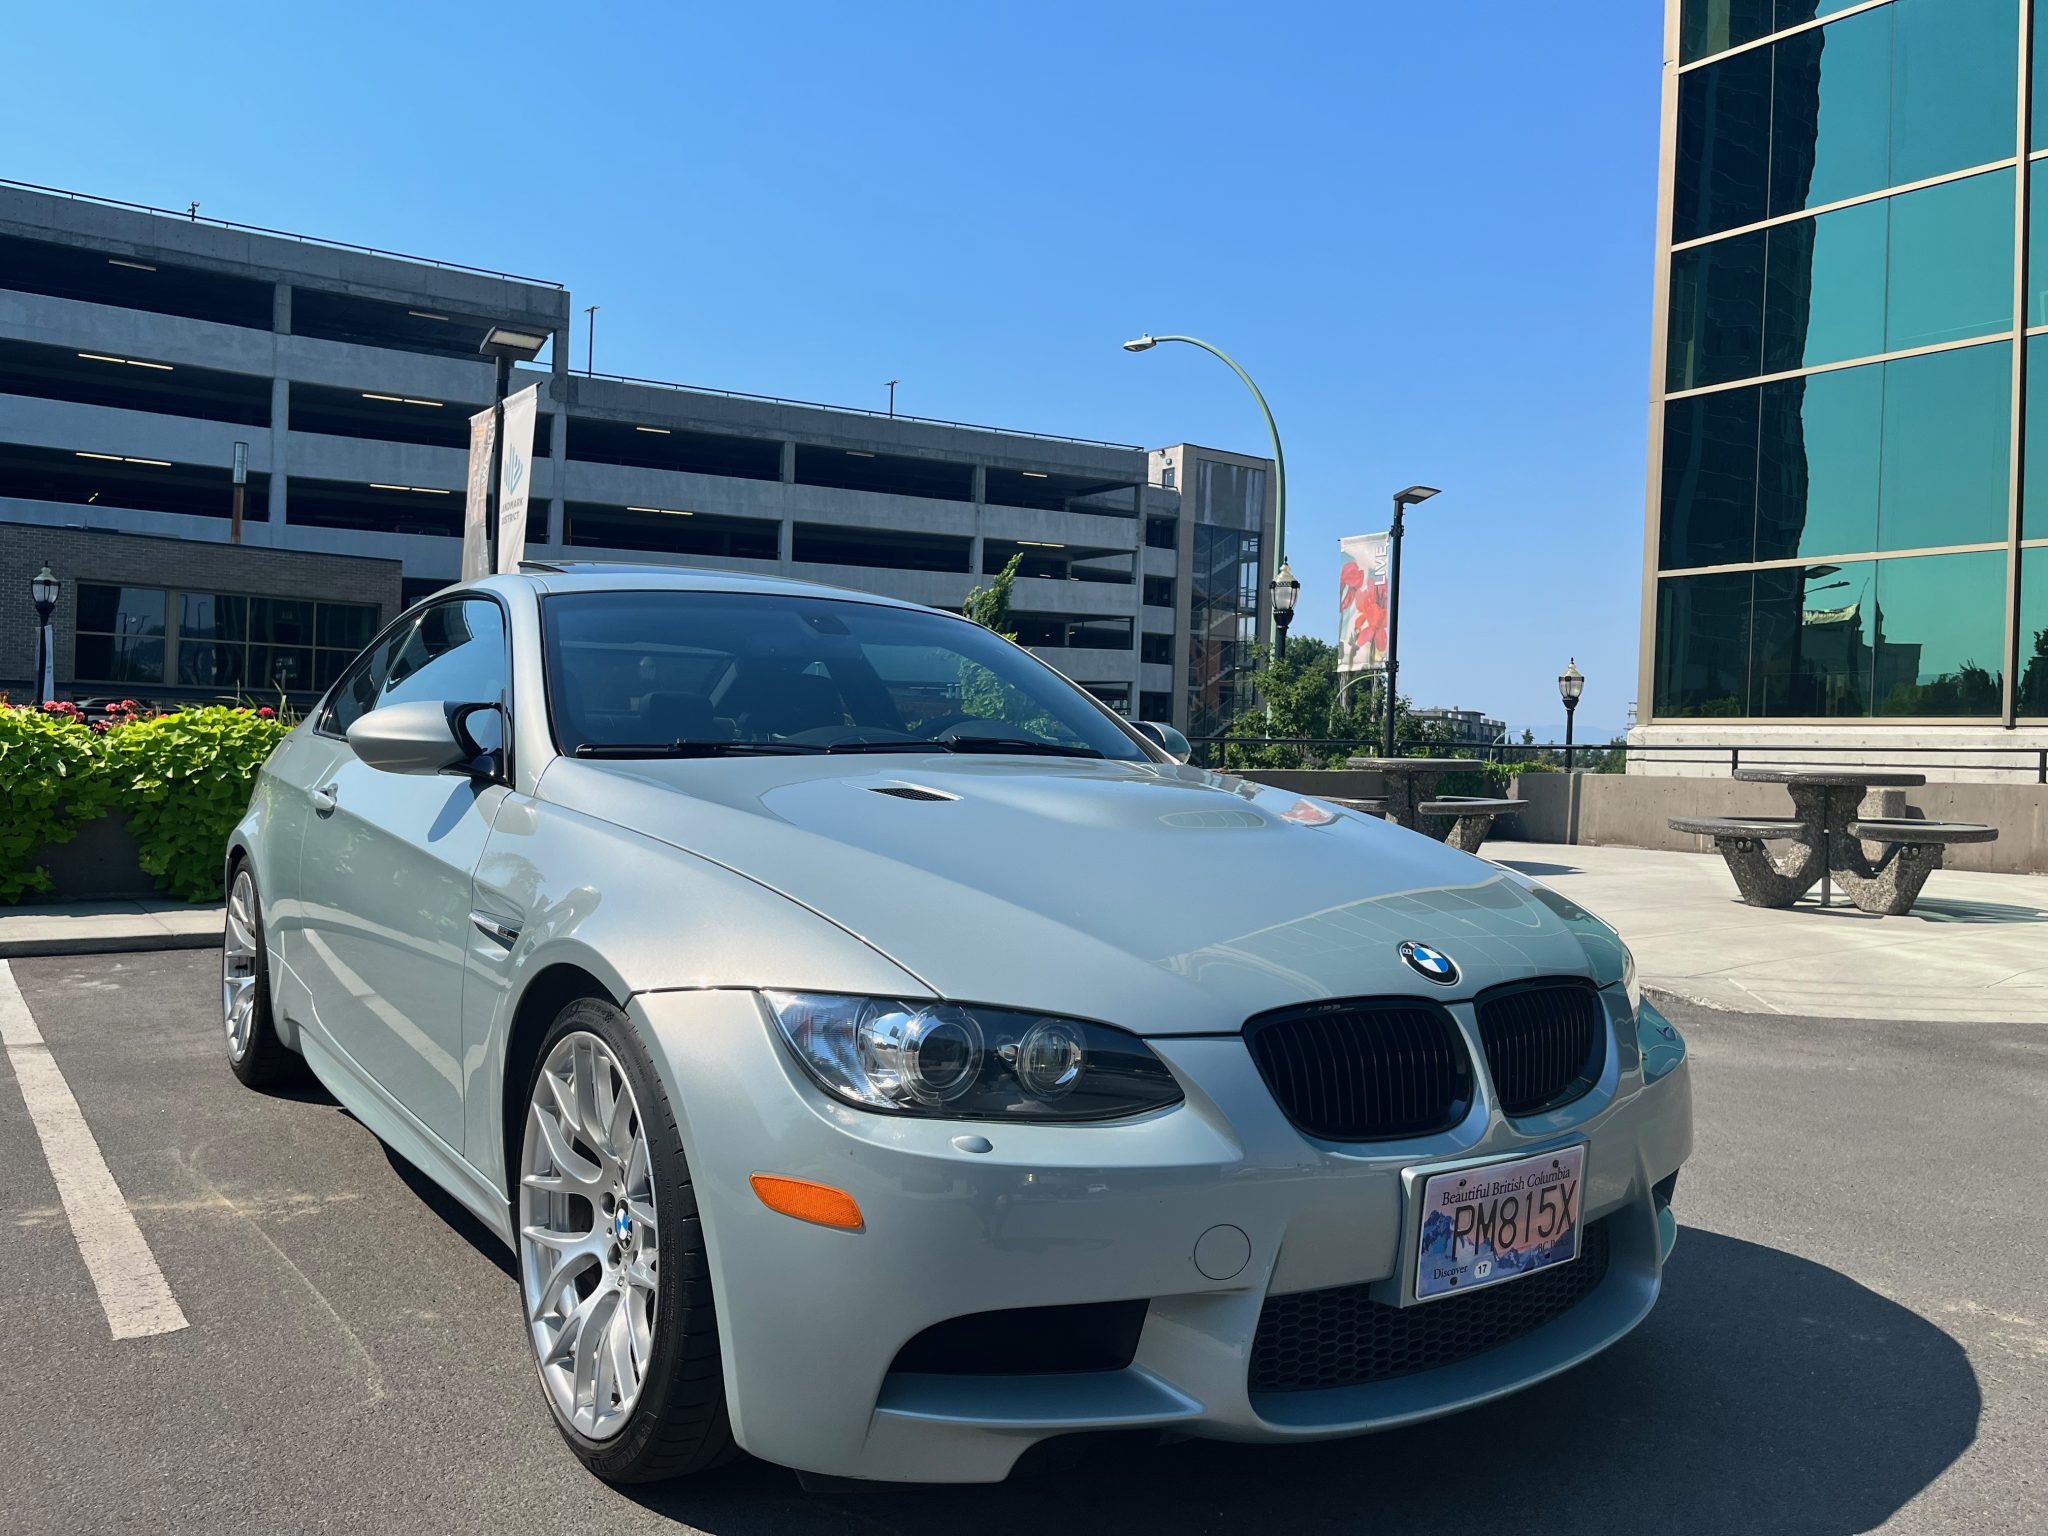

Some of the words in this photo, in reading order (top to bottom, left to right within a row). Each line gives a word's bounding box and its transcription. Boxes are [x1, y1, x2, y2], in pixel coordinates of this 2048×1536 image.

[501, 497, 524, 514] ANDMARK
[1374, 545, 1387, 586] LIVE
[1441, 1183, 1490, 1206] Beautiful
[1492, 1176, 1525, 1196] British
[1527, 1166, 1570, 1187] Columbia
[1453, 1180, 1577, 1263] PM815X
[1433, 1264, 1468, 1280] Discover
[1478, 1263, 1488, 1275] 17
